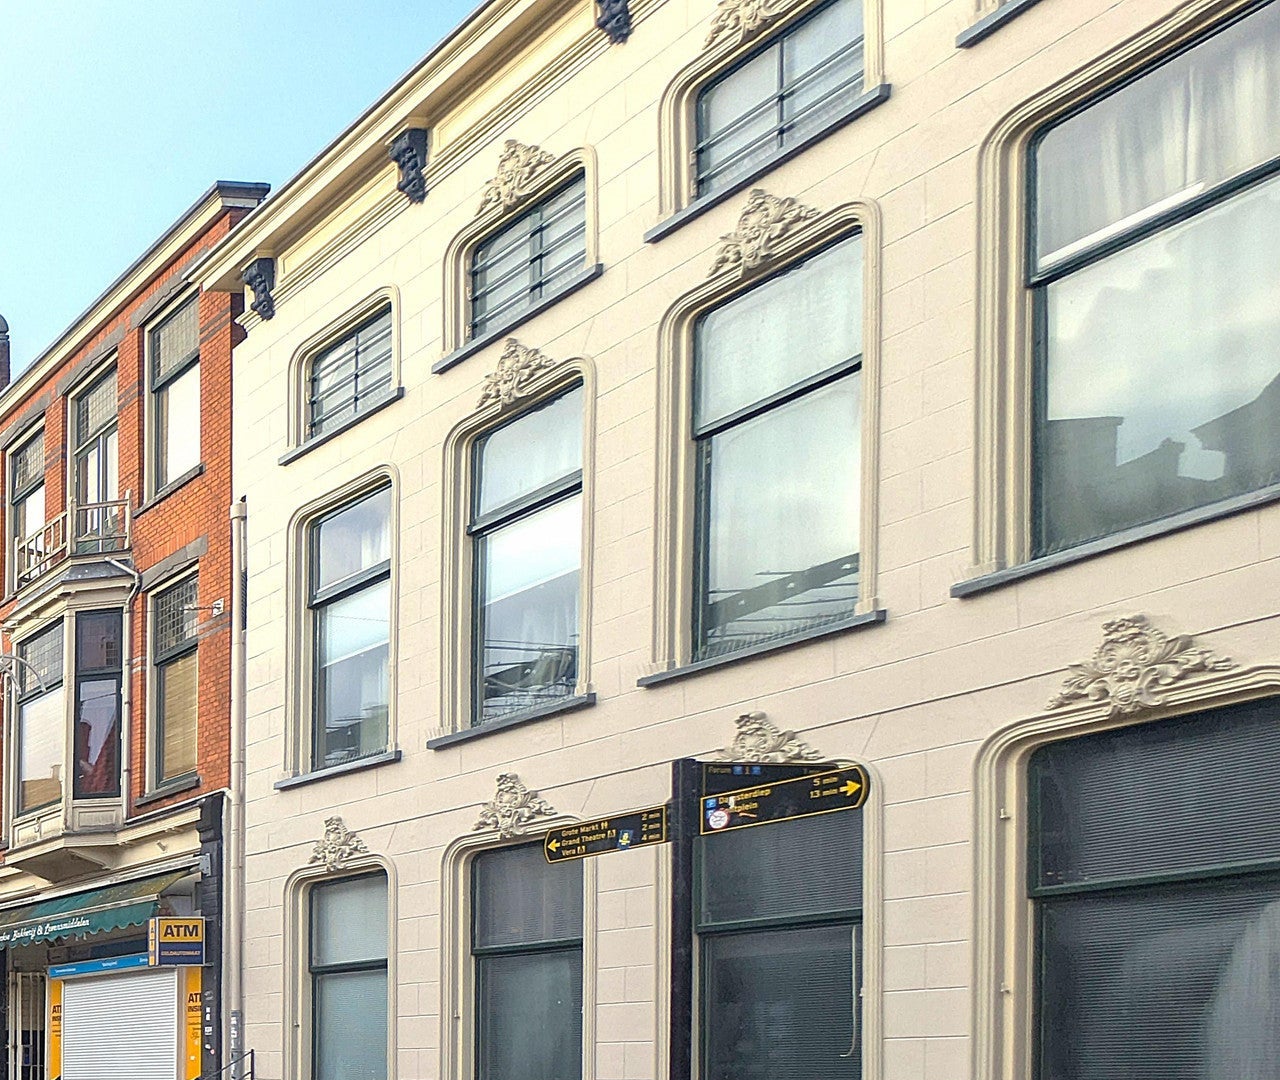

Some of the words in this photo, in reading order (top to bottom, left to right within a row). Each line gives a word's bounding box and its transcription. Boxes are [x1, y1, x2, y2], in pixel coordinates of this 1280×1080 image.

[822, 777, 839, 785] min
[719, 788, 772, 805] Dasterdiep
[810, 790, 820, 799] 13
[822, 788, 838, 796] min
[561, 829, 579, 837] Grote
[580, 824, 599, 833] Markt
[561, 837, 580, 847] Grand
[581, 833, 606, 842] Theatre
[164, 925, 199, 938] ATM
